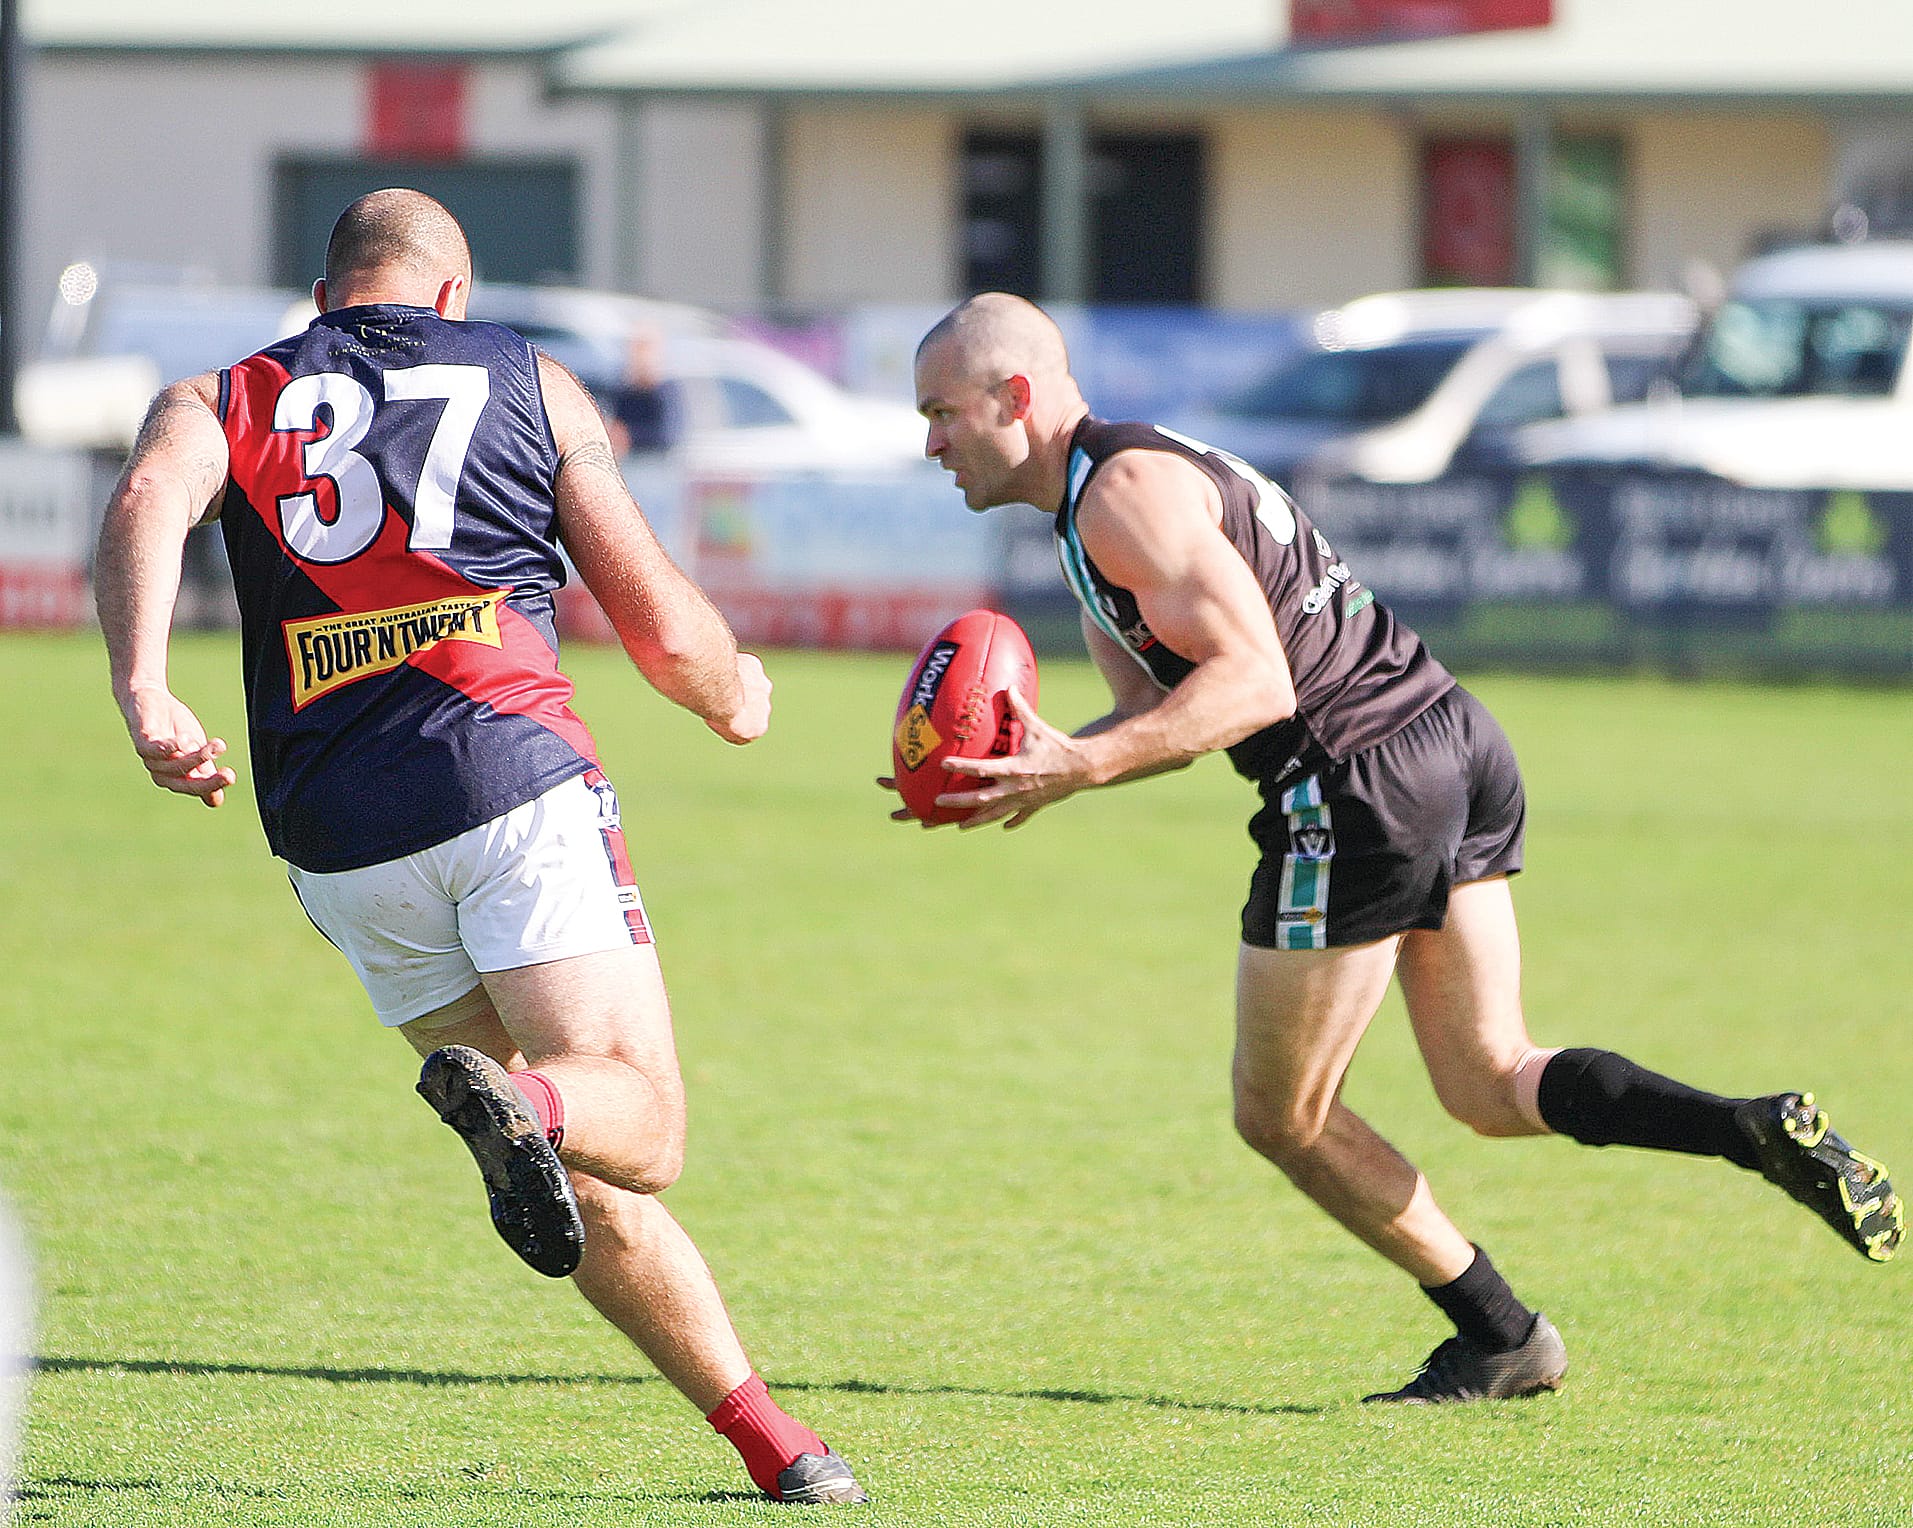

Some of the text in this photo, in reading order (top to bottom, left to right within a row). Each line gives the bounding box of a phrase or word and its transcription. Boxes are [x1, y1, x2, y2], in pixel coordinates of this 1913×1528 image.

[273, 363, 491, 565] 37
[322, 623, 342, 633] THE
[345, 617, 377, 629] GREAT
[379, 605, 439, 623] AUSTRALIAN
